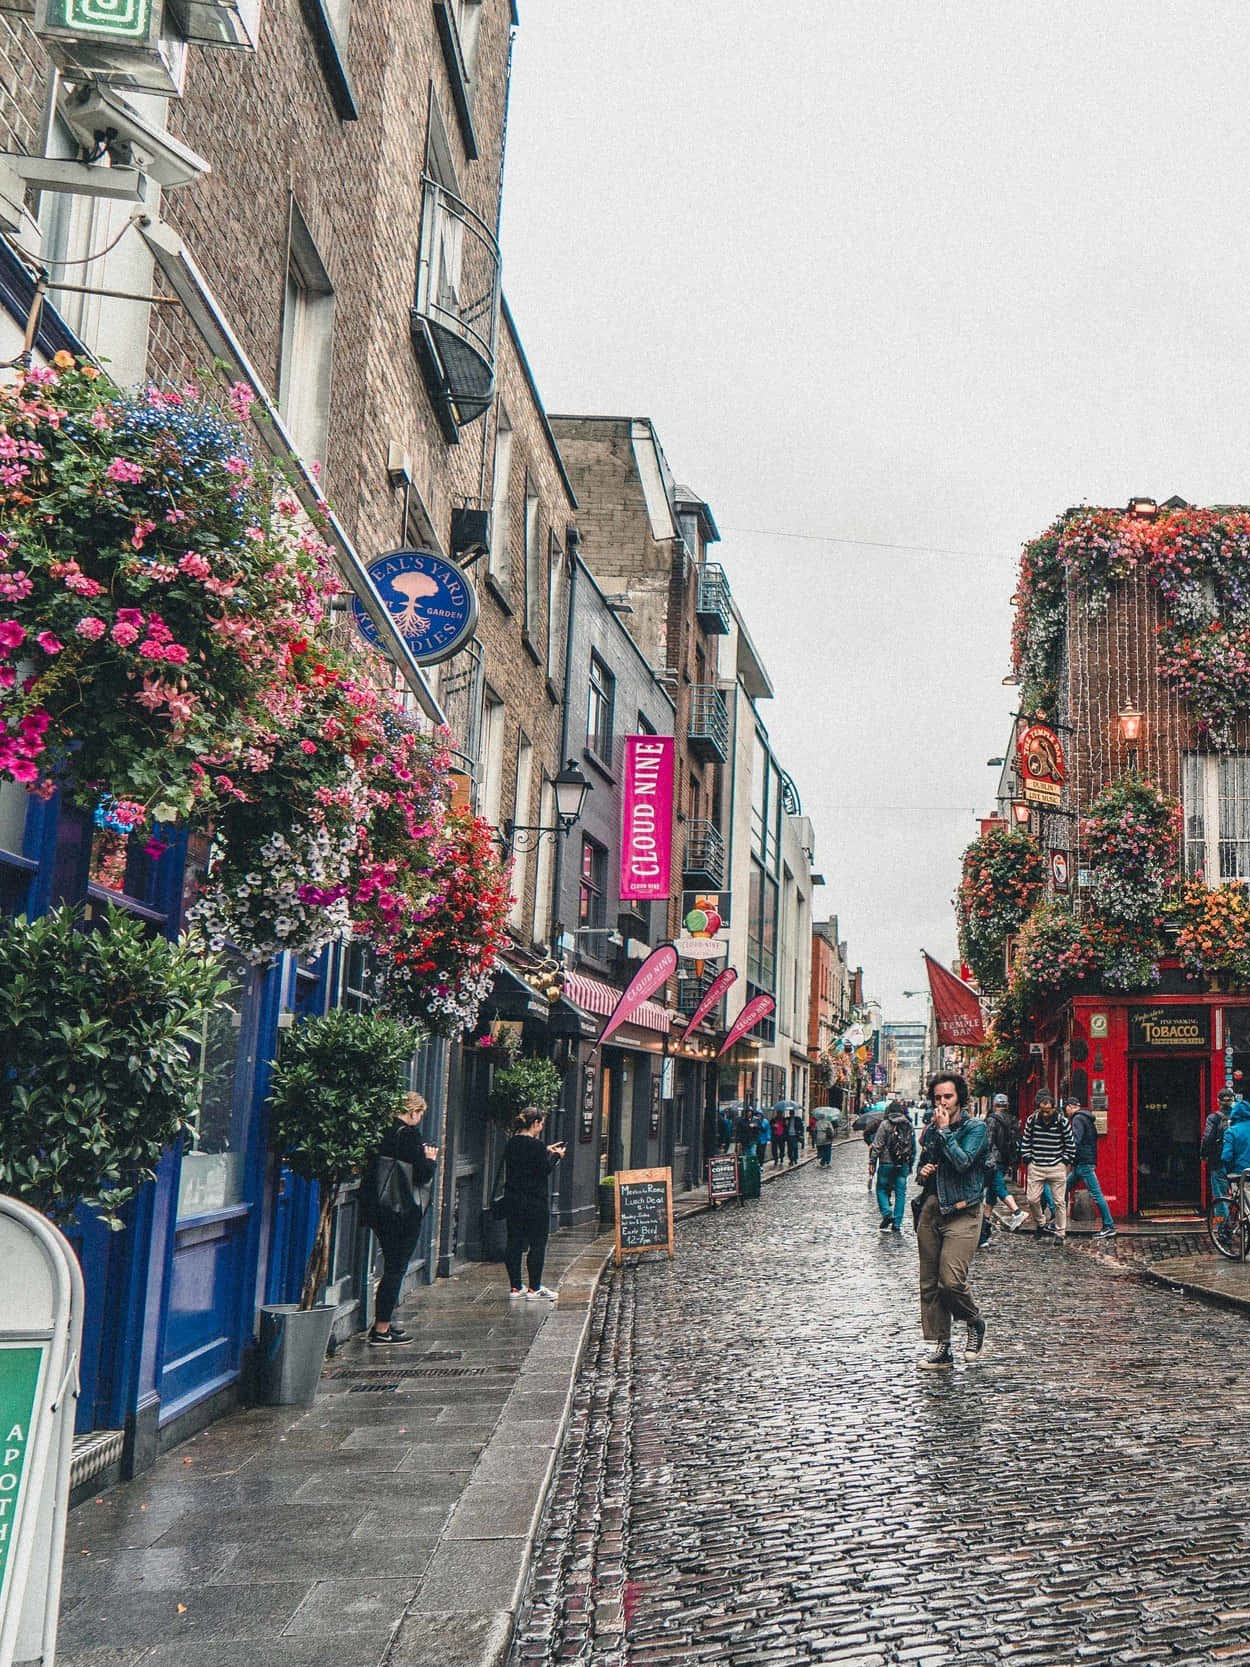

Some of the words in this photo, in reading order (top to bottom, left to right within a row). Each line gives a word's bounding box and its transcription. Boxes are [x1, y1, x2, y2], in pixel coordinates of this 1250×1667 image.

[371, 557, 424, 581] EAL'S
[431, 562, 464, 606] YARD
[357, 612, 457, 652] REDIES
[426, 607, 463, 619] GARDEN
[634, 742, 664, 795] NINE
[631, 804, 659, 876] CLOUD
[627, 972, 653, 1000] CLOUD
[653, 953, 673, 974] NINE
[943, 1019, 979, 1030] TEMPLE
[625, 1197, 645, 1206] Lunch
